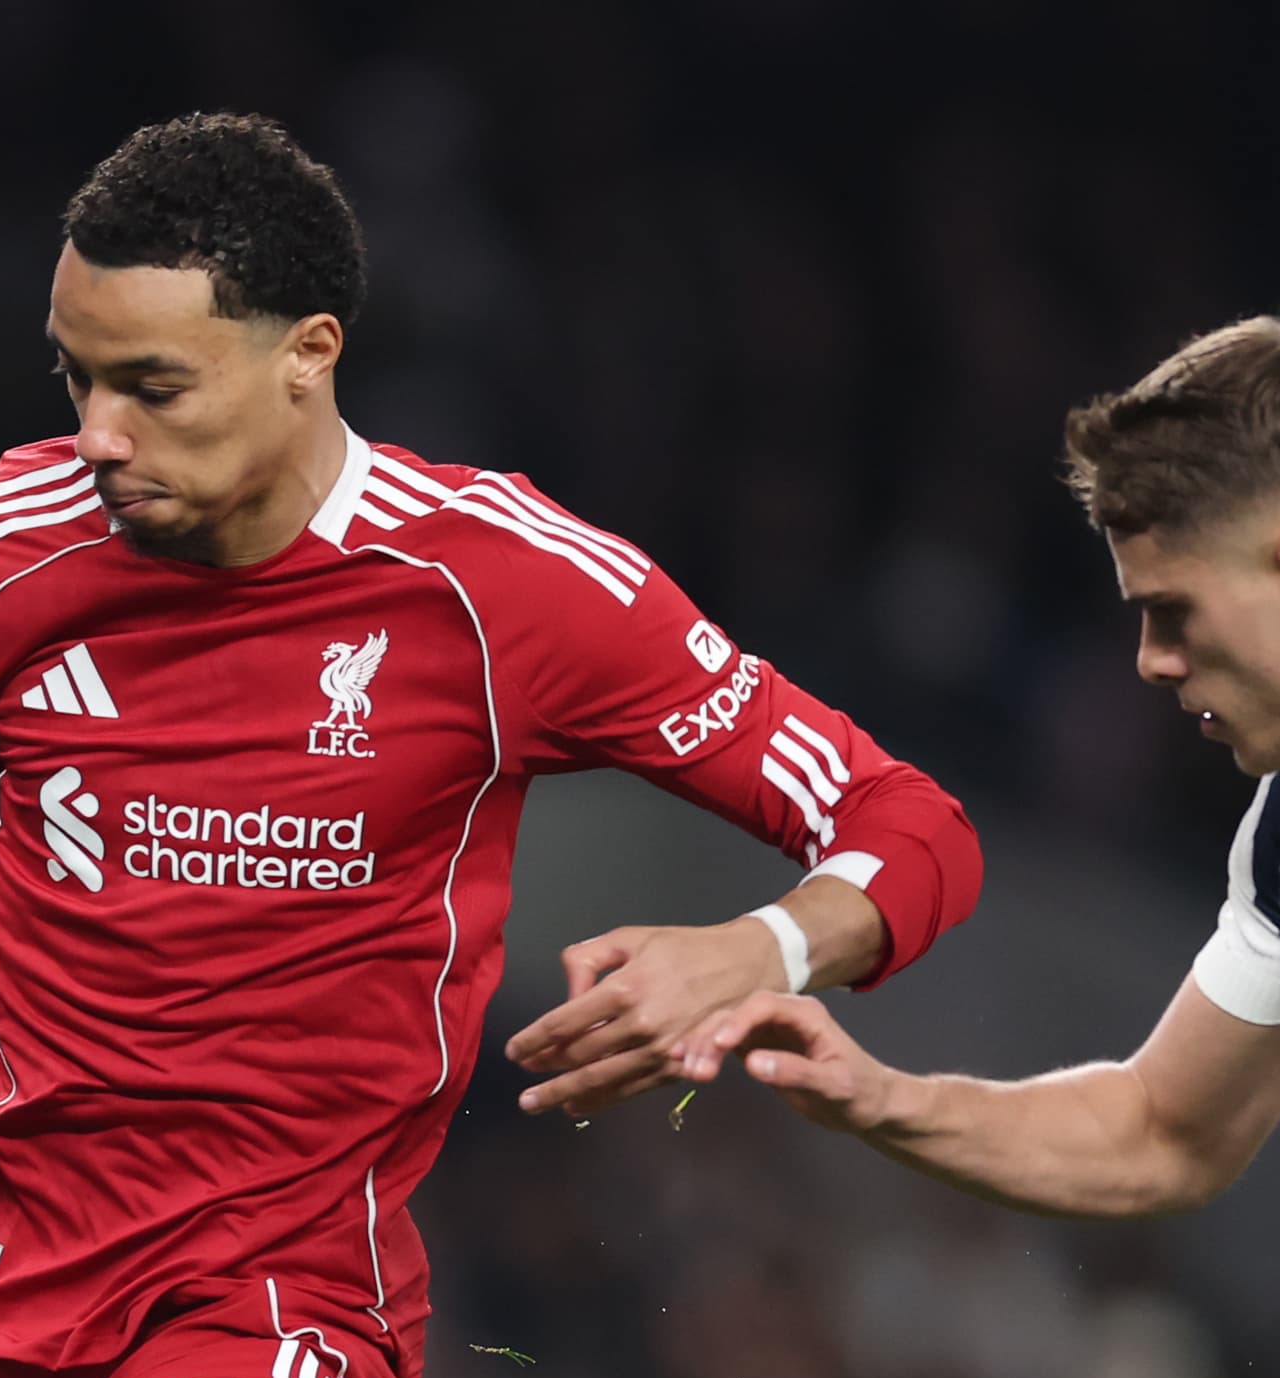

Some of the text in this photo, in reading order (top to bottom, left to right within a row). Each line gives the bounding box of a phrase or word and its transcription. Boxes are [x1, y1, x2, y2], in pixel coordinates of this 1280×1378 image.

[306, 728, 376, 758] L.F.C.
[123, 794, 365, 851] standard
[123, 838, 376, 890] chartered
